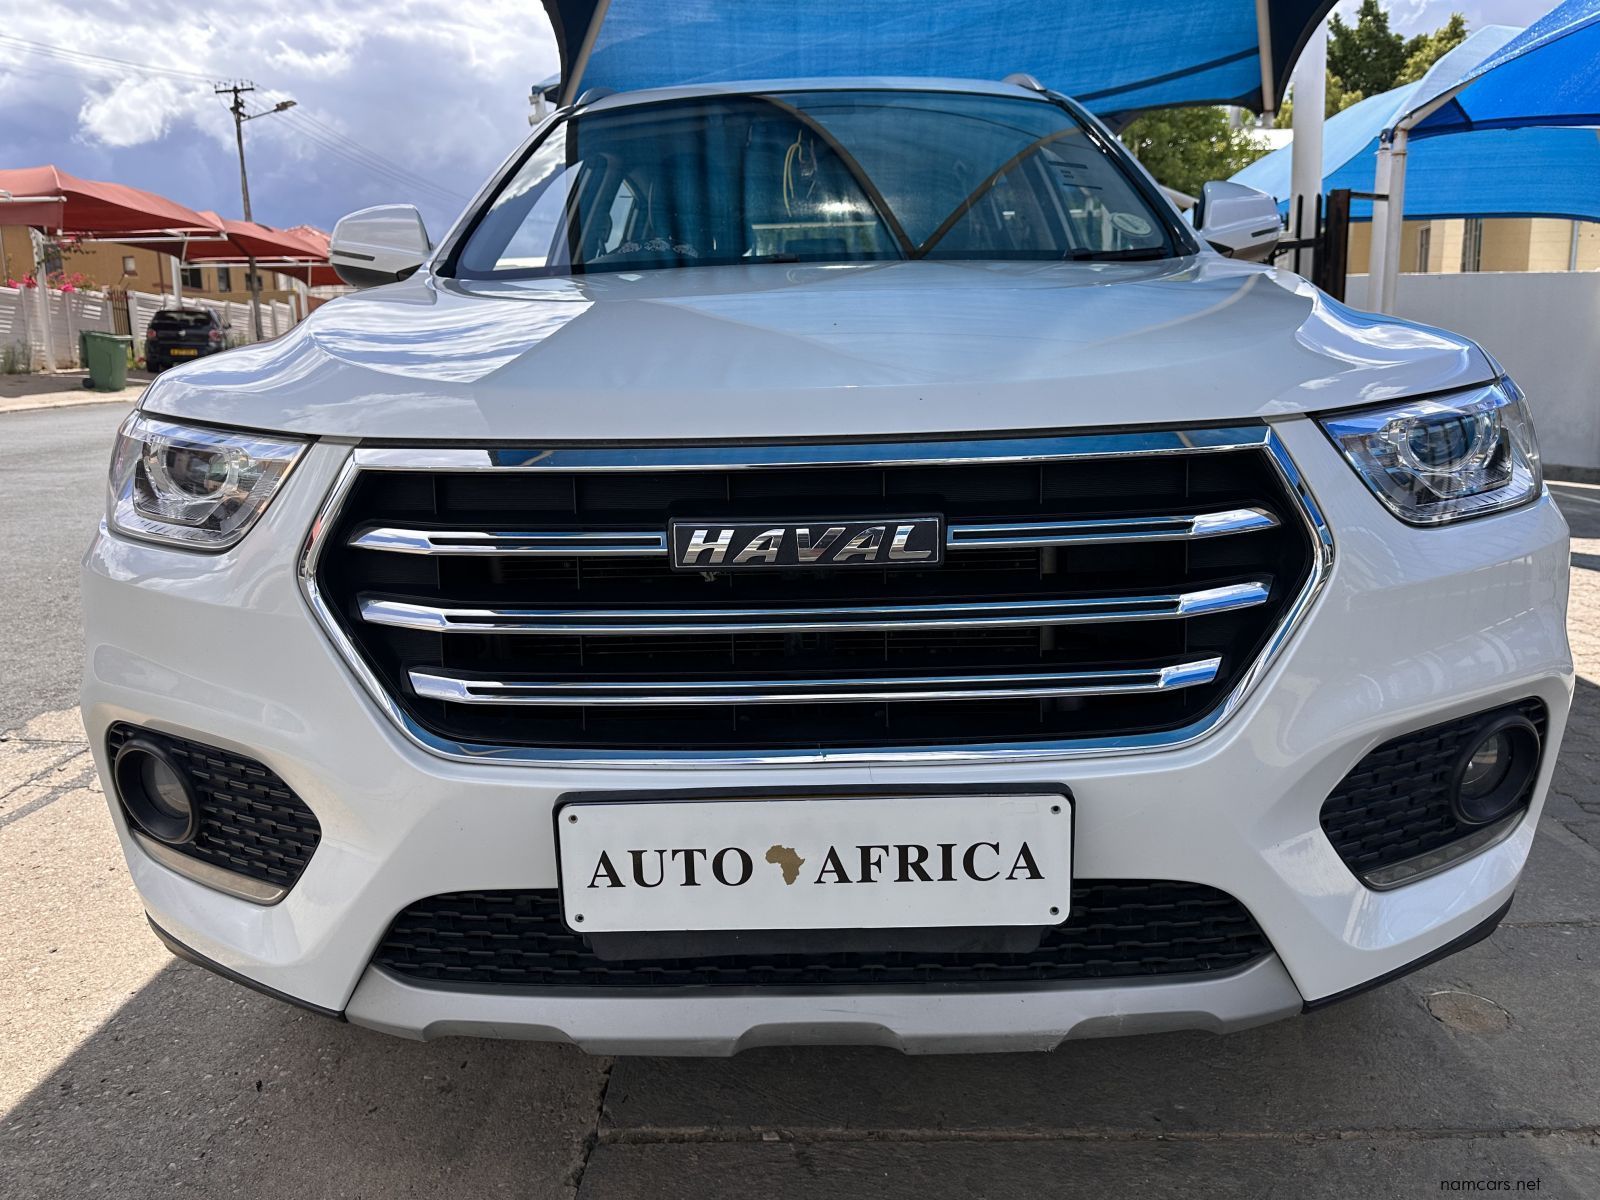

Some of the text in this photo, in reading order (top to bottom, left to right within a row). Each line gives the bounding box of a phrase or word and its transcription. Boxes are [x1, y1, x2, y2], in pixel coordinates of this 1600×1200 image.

[683, 525, 932, 564] HAVAL
[587, 841, 1046, 888] AUTO AFRICA
